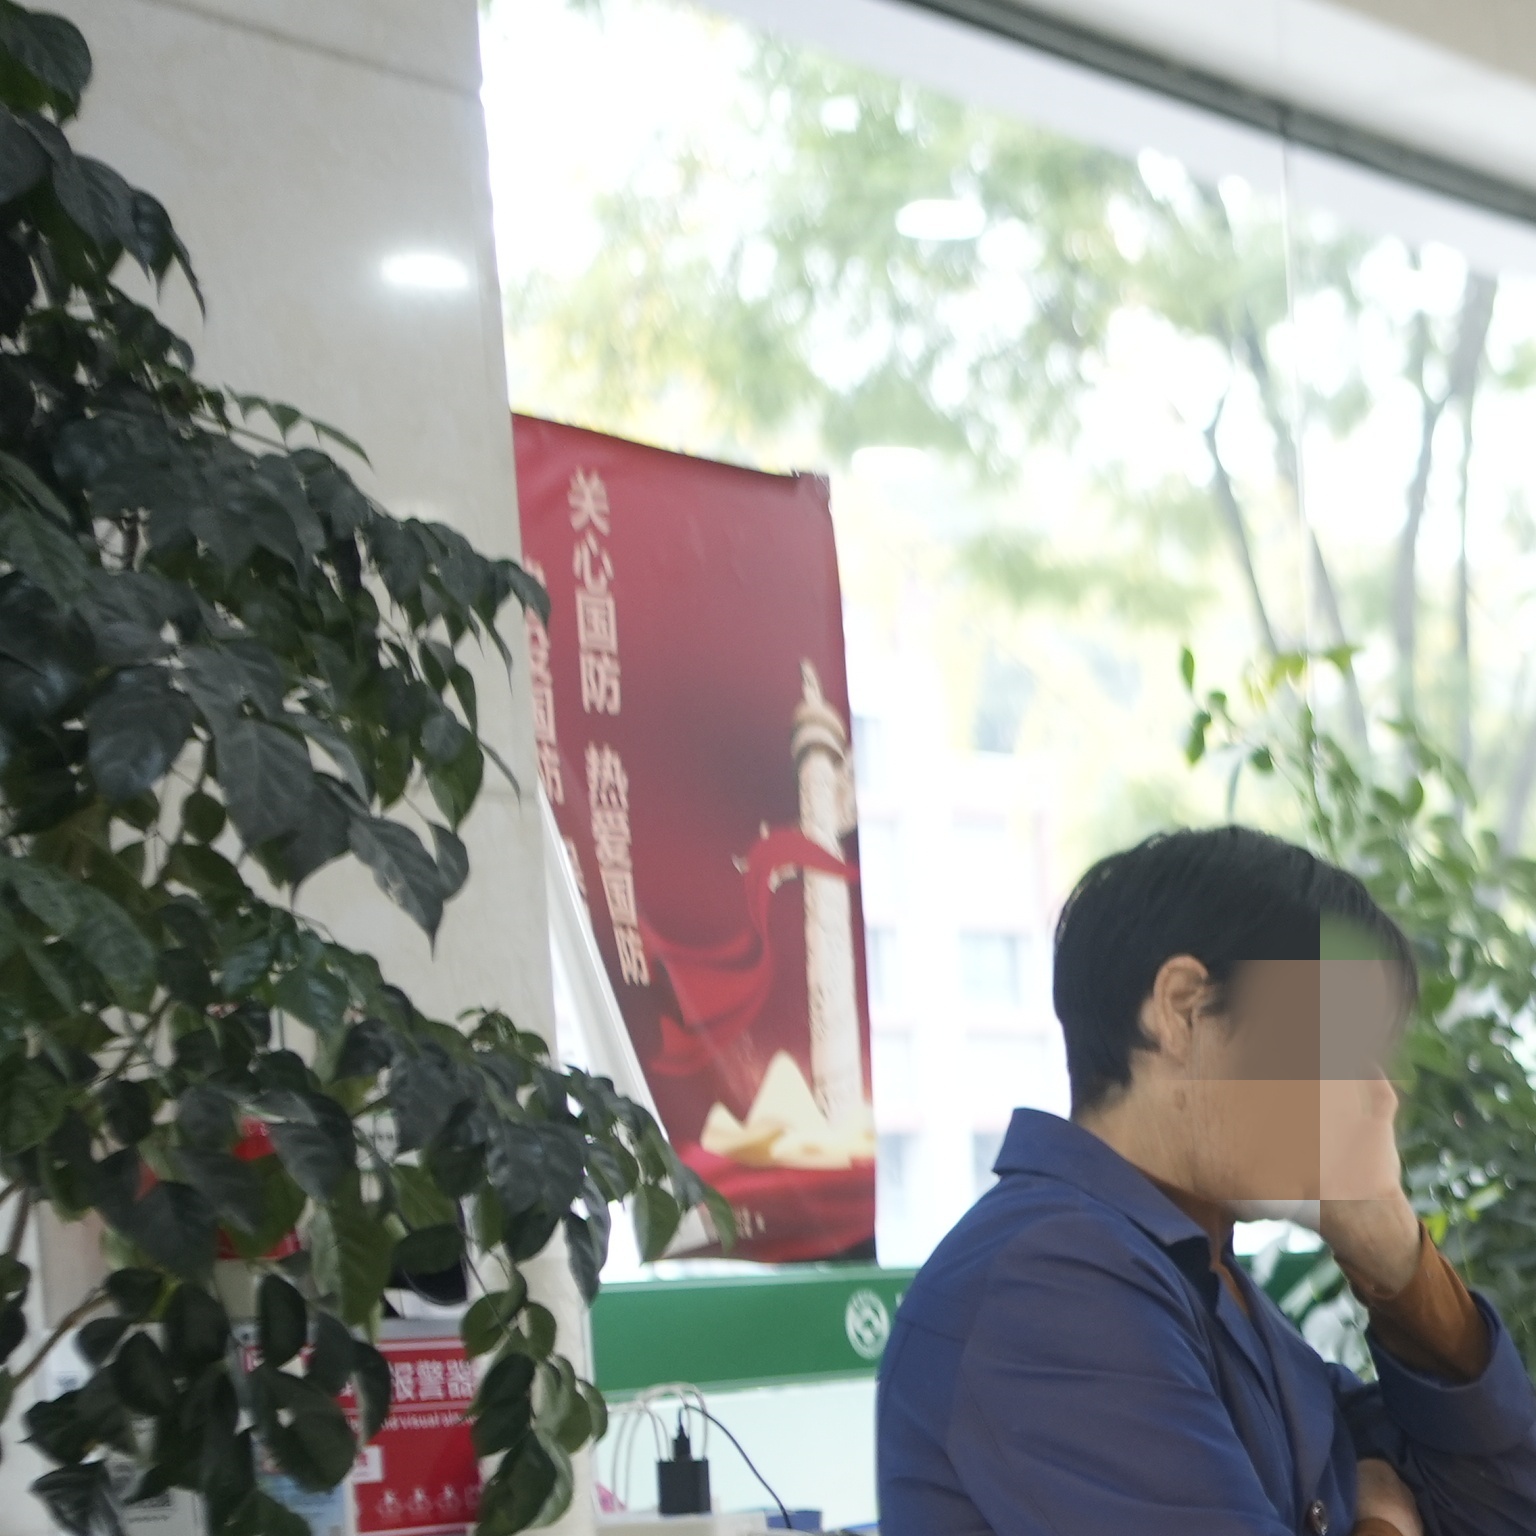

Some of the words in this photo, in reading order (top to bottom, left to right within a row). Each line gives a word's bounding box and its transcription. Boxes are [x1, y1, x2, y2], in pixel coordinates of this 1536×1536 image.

[566, 464, 622, 716] 关心国防
[584, 740, 650, 986] 热爱国防
